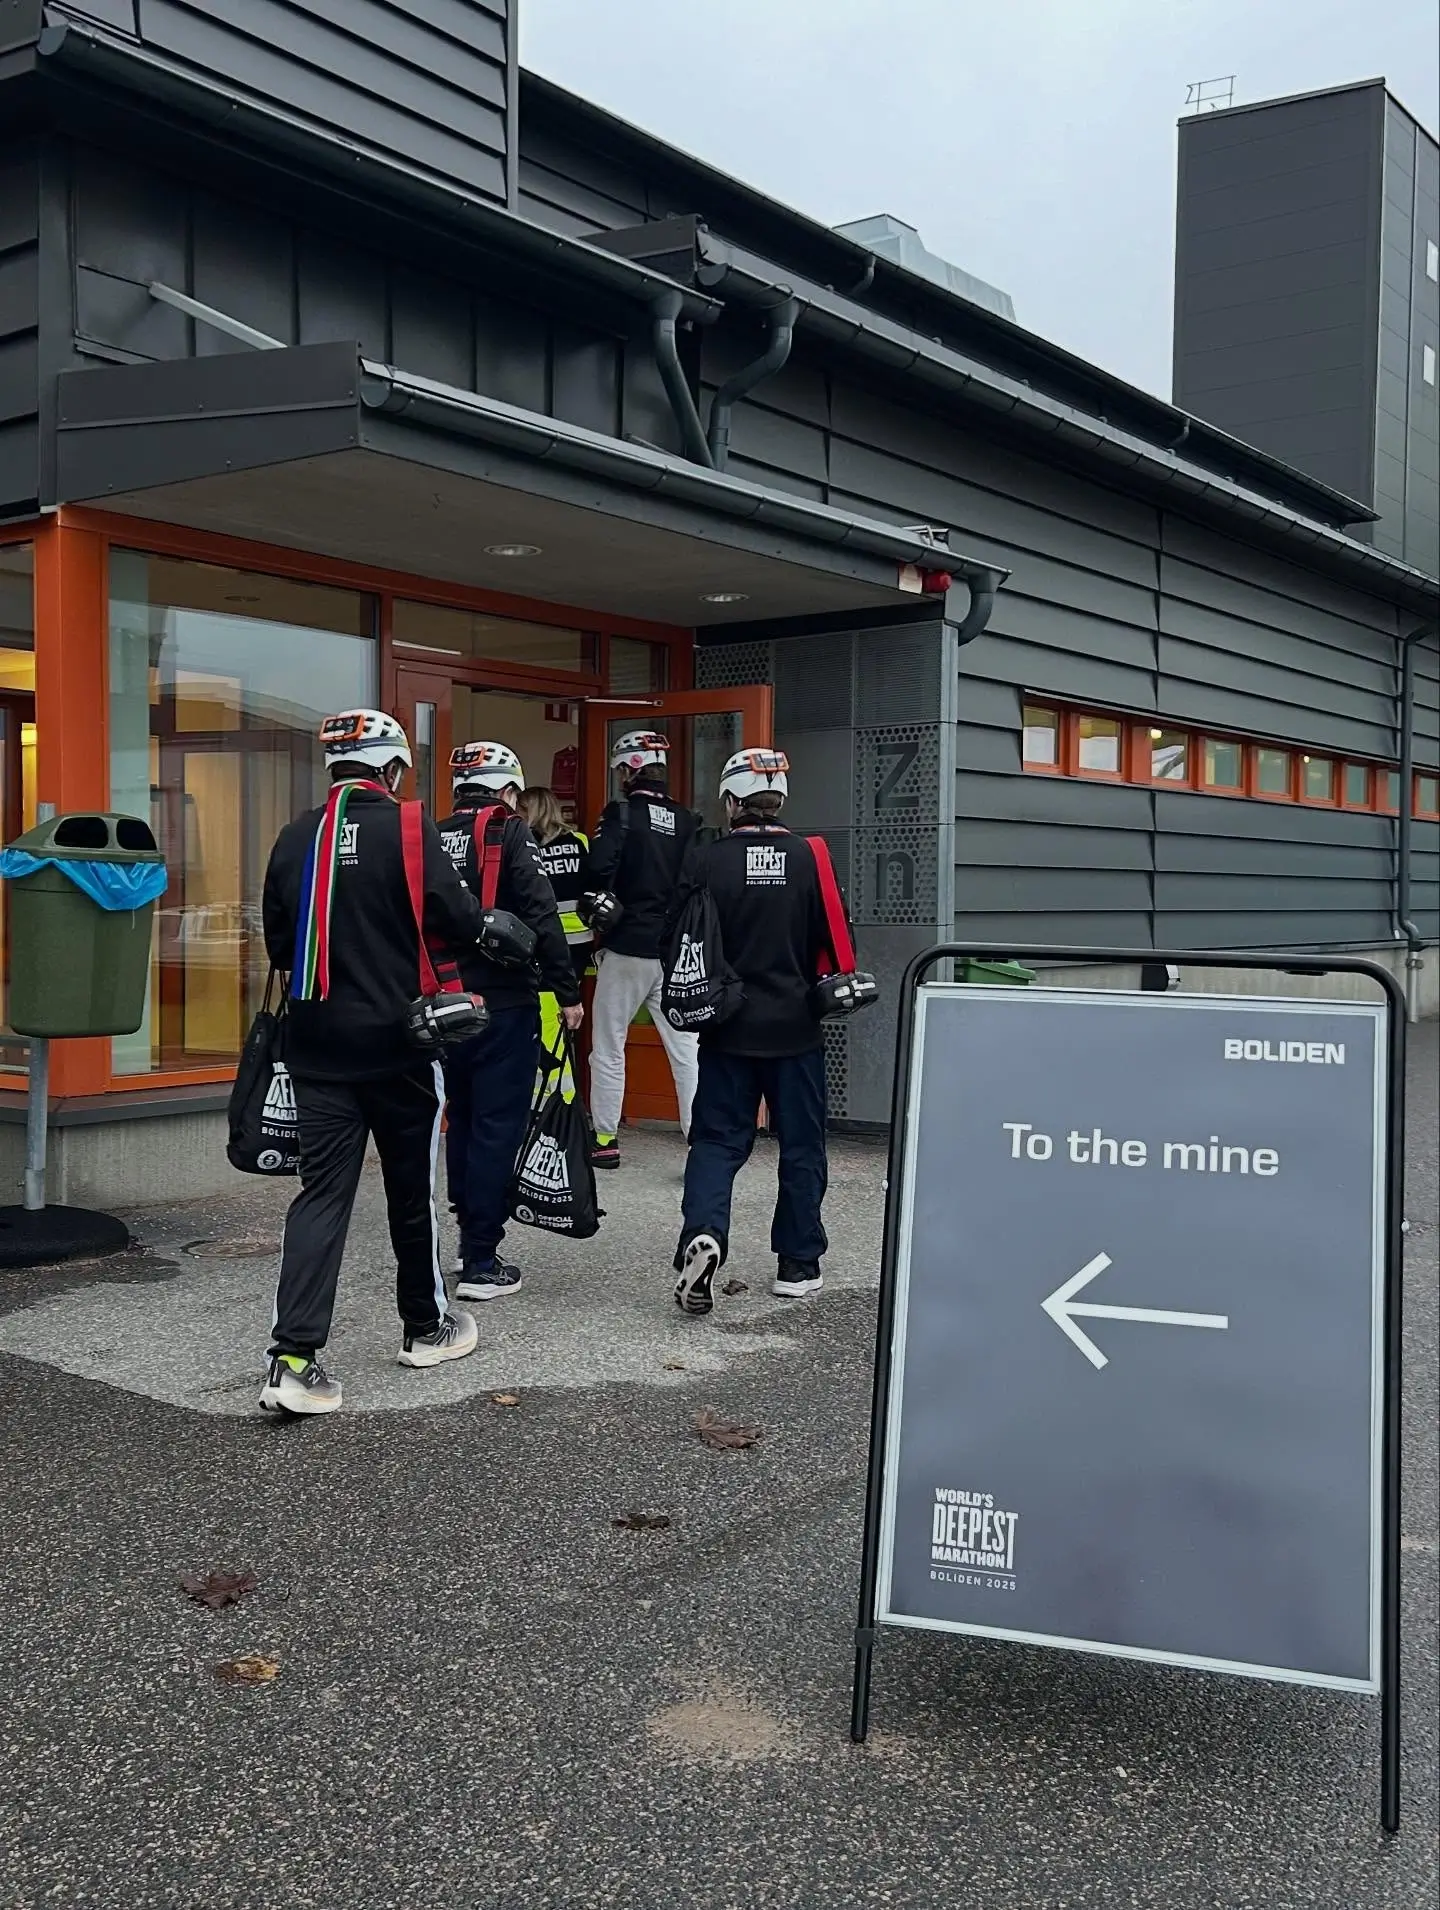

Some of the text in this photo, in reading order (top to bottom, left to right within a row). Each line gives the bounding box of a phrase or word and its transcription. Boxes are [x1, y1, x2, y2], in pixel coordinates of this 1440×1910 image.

[543, 858, 580, 875] REW
[746, 852, 787, 876] DEEPEST
[1224, 1039, 1345, 1064] BOLIDEN
[261, 1126, 299, 1138] BOLIDE
[1003, 1122, 1279, 1176] To the mine
[518, 1185, 573, 1204] BOLIDEN 2025
[537, 1214, 574, 1223] OFFICIAL
[935, 1488, 994, 1508] WORLD'S
[932, 1503, 1018, 1569] DEEPEST
[931, 1545, 1005, 1568] MARATHON
[930, 1570, 1017, 1591] BOLIDEN 2025
